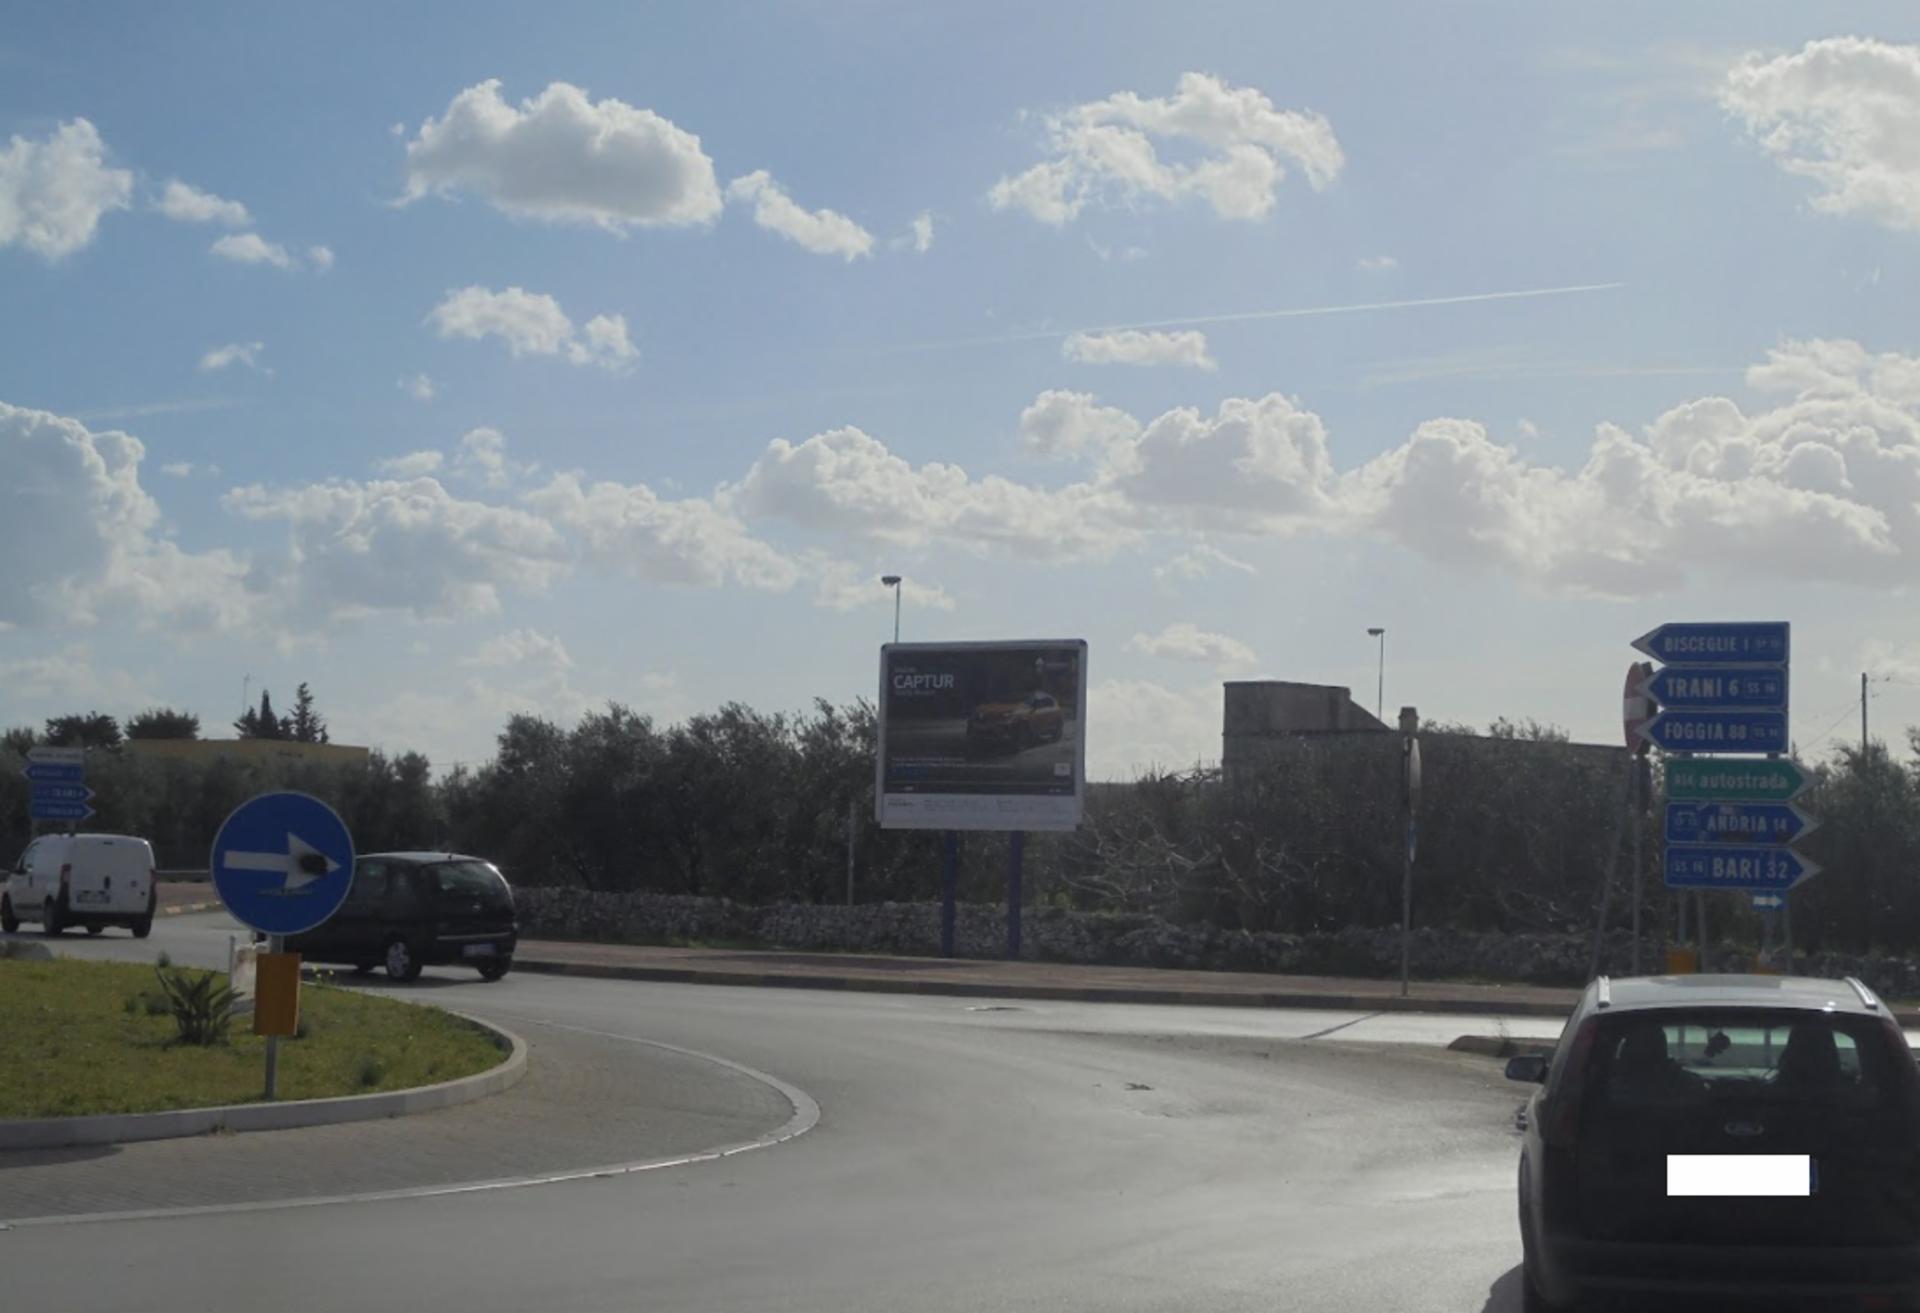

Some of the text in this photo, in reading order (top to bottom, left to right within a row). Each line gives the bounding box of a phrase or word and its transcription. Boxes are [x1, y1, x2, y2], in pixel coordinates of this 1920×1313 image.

[1664, 637, 1736, 652] BISCEGLIE
[893, 673, 954, 689] CAPTUR
[1666, 678, 1721, 698] TRANI
[1729, 679, 1739, 696] 6
[1664, 722, 1724, 740] FOGGIA
[1699, 771, 1788, 789] autostrada
[1706, 815, 1767, 833] ANDRIA
[1773, 817, 1788, 832] 14
[1712, 858, 1761, 879] BARI
[1766, 861, 1788, 879] 32
